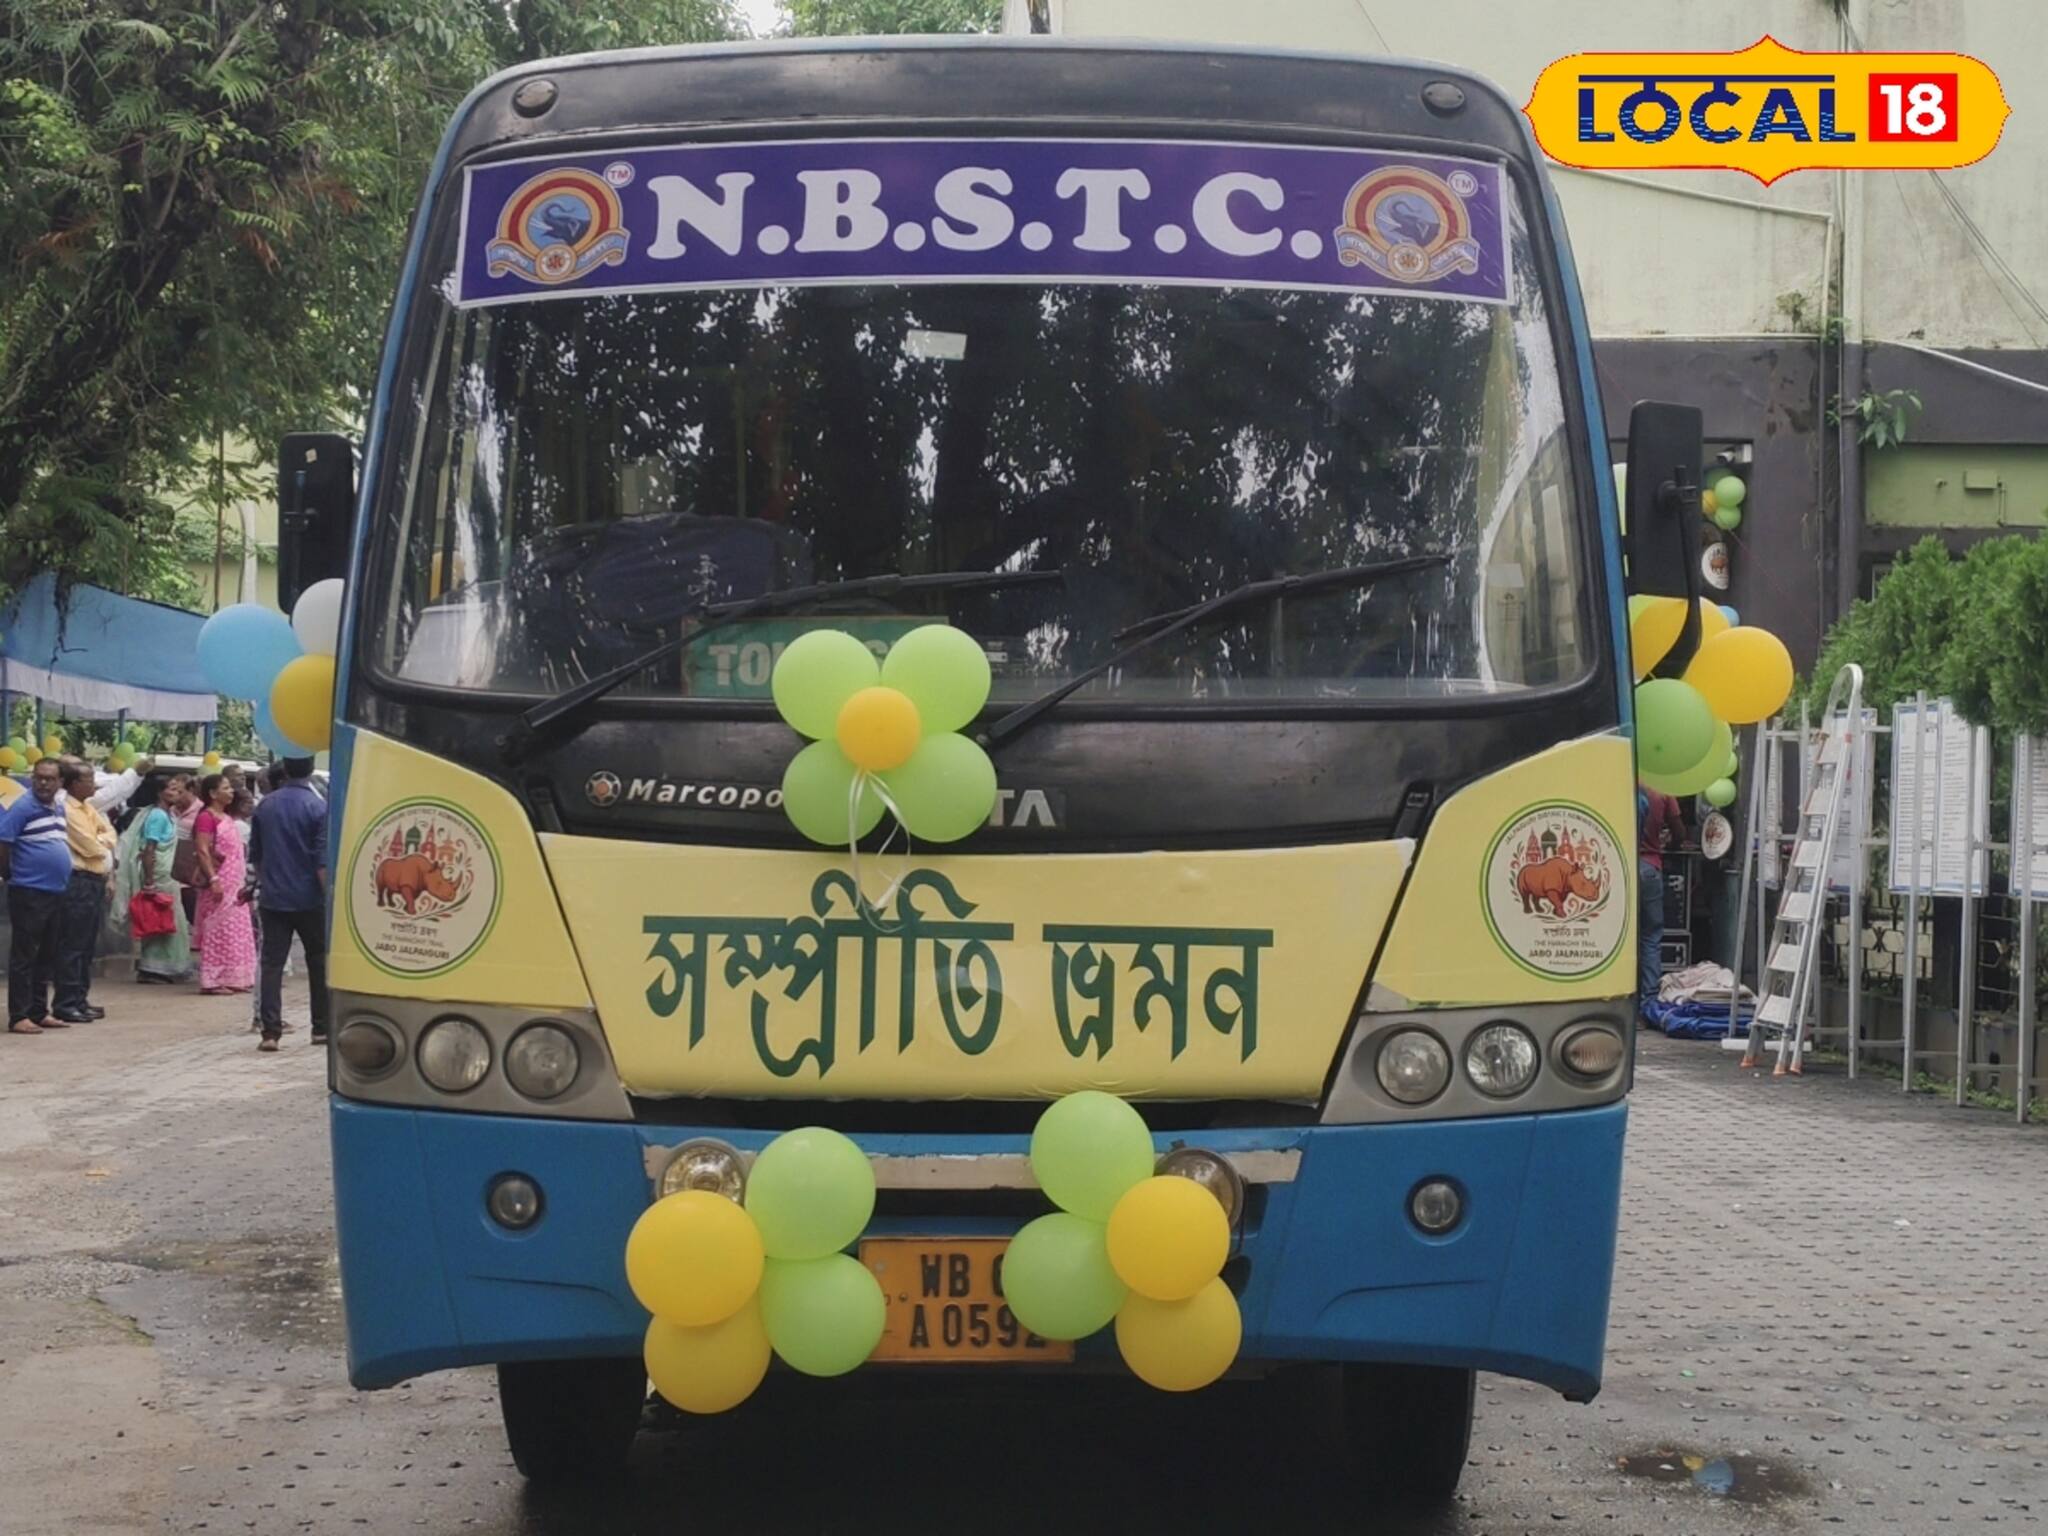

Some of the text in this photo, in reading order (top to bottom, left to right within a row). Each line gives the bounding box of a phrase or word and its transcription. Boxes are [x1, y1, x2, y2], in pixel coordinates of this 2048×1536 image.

[645, 165, 1324, 260] N.B.S.T.C.
[626, 778, 784, 810] Marcopo
[988, 789, 1057, 827] TA
[920, 1253, 971, 1299] WB
